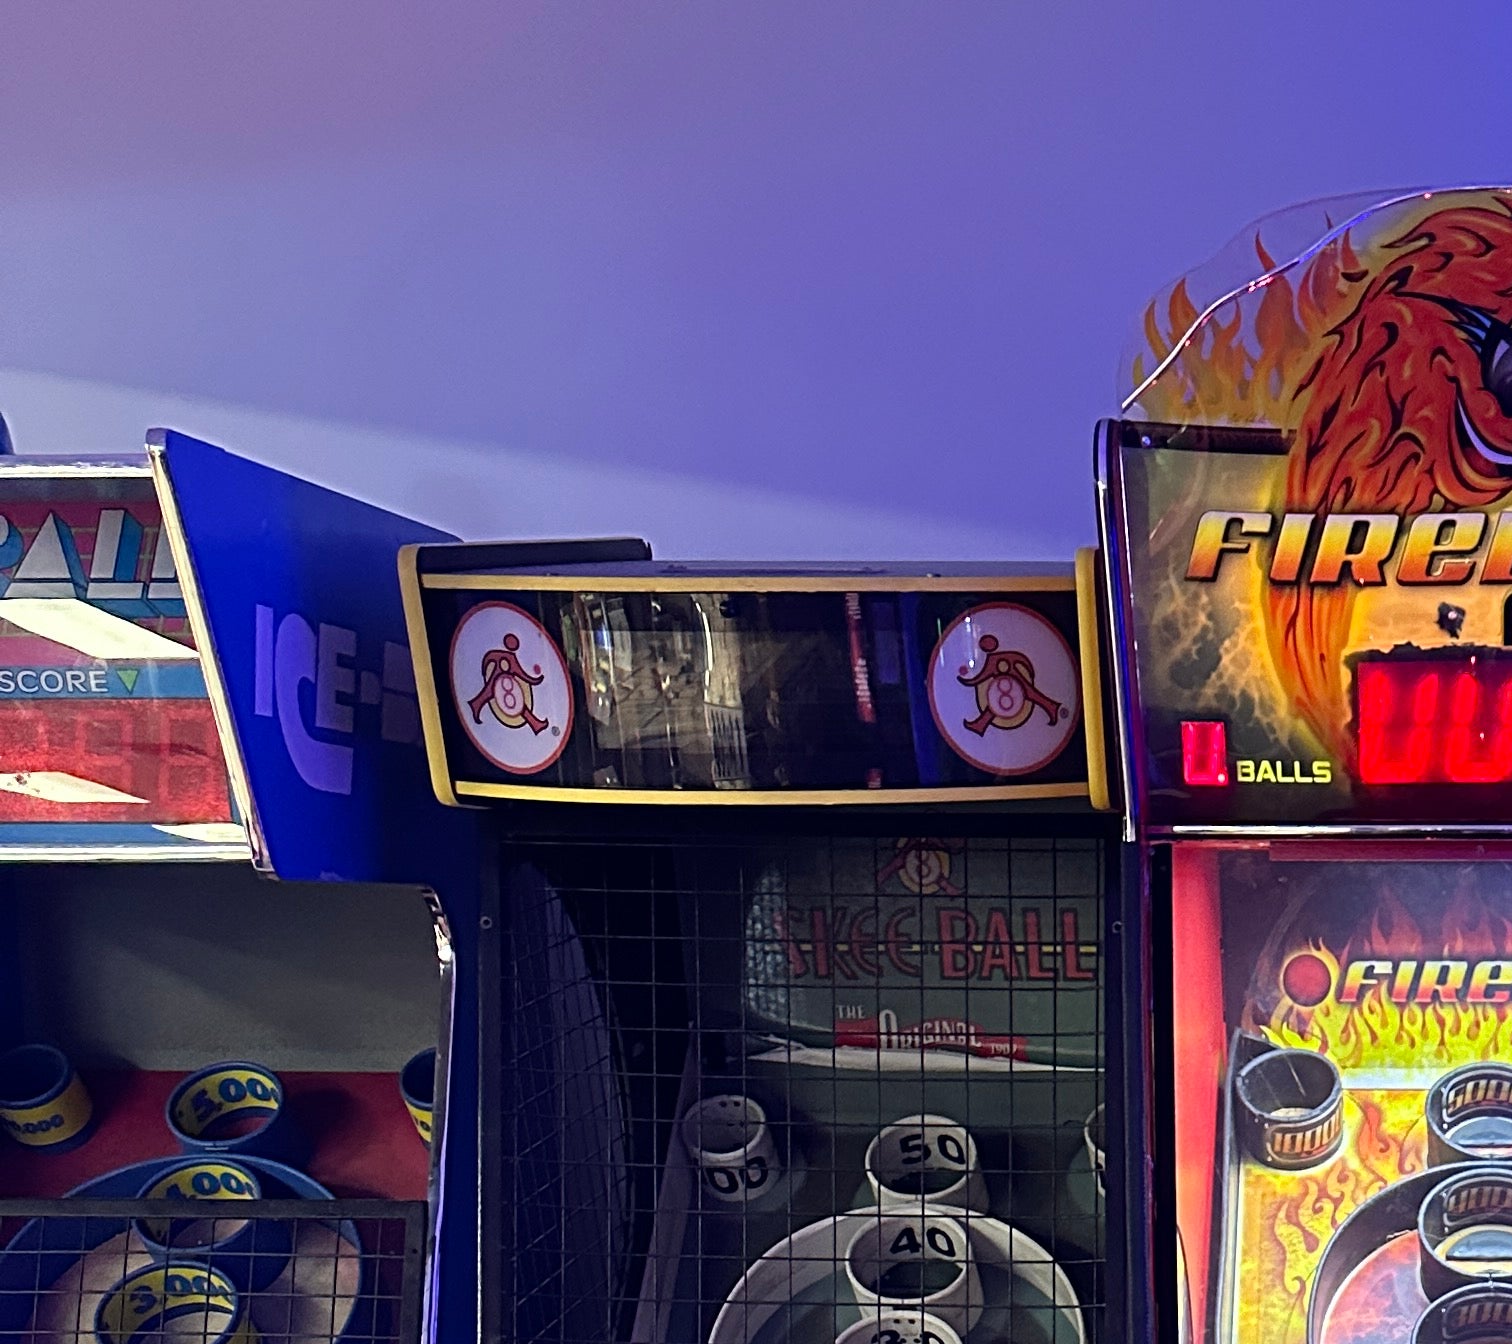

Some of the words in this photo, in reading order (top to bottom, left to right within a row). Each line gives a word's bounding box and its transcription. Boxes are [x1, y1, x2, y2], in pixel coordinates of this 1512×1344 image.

[0, 669, 108, 693] SCORE
[1236, 760, 1332, 784] BALLS
[900, 1132, 965, 1166] 50
[889, 1226, 958, 1259] 40
